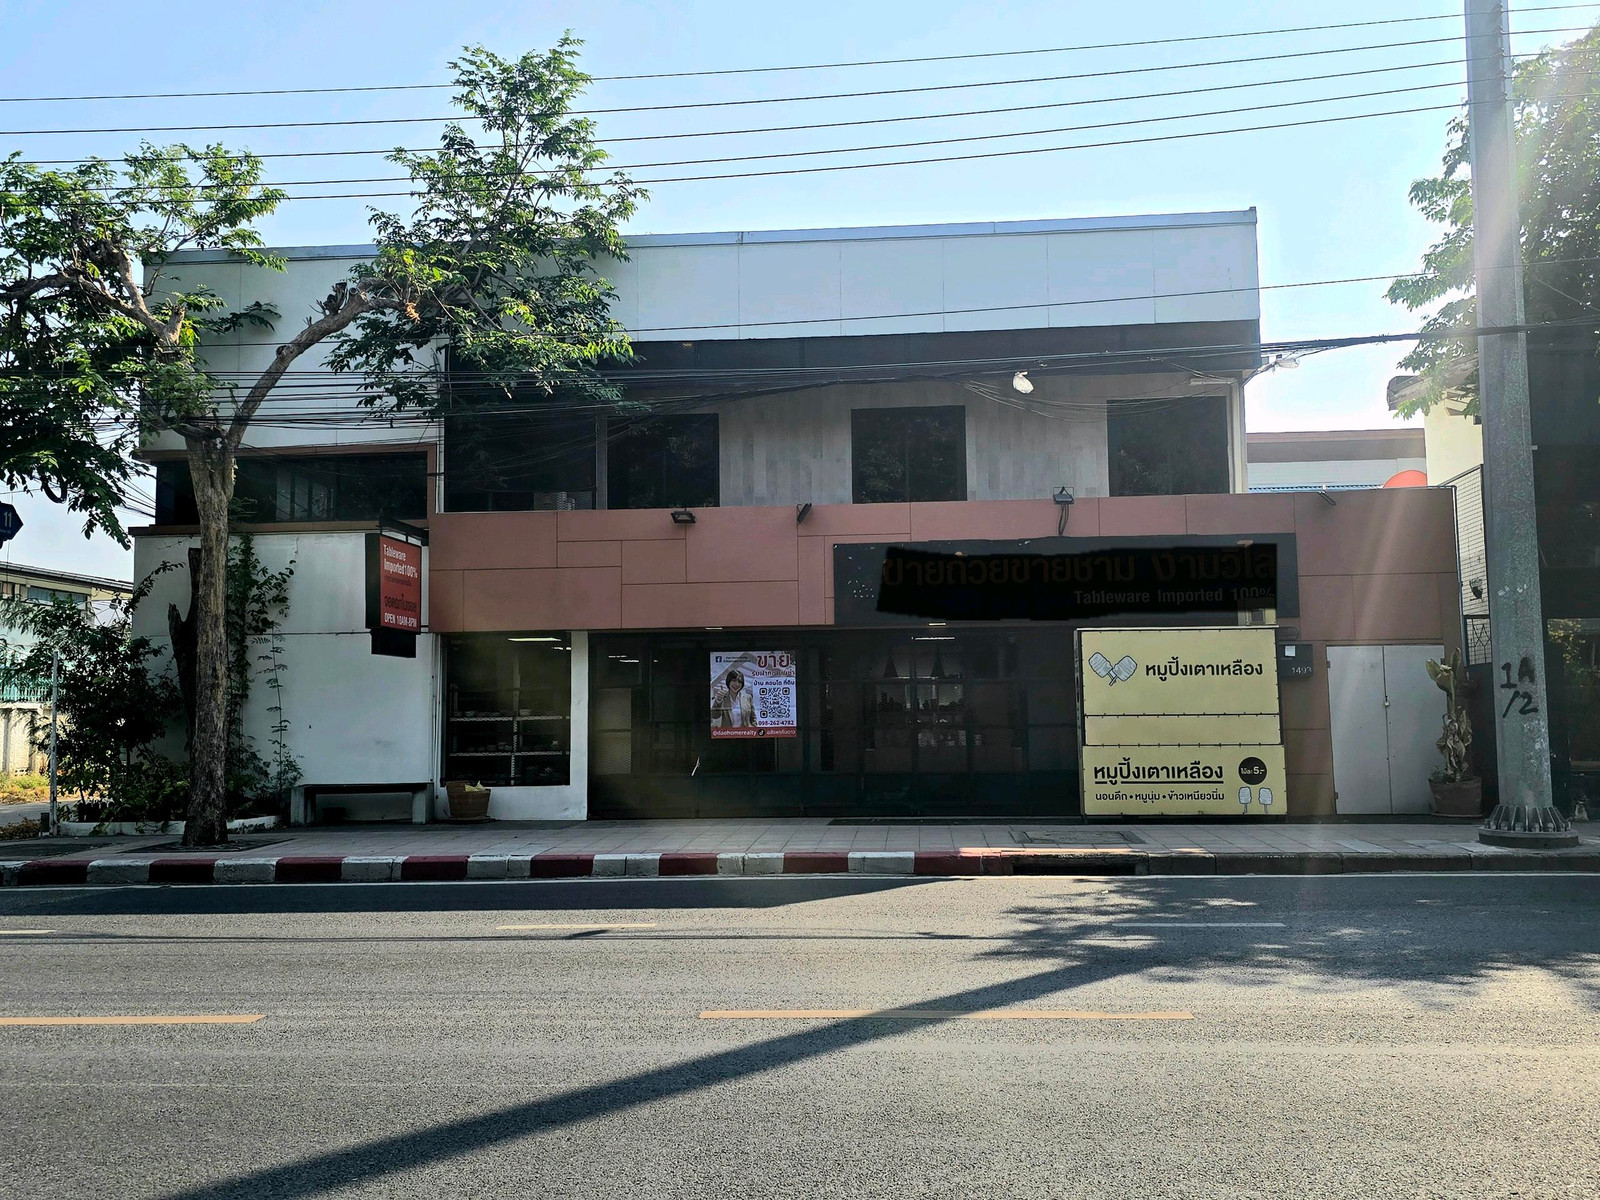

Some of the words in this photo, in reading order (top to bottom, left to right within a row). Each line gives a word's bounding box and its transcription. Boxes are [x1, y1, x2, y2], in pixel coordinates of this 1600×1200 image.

[383, 544, 405, 561] Tableware
[1073, 589, 1151, 605] Tableware
[1158, 588, 1223, 605] Imported
[384, 612, 396, 624] OPEN
[757, 655, 790, 667] ขาย
[1145, 656, 1264, 682] หมูปิ้งเตาเหลือง
[712, 729, 757, 737] @daohomerealty
[1094, 757, 1224, 786] หมูปิ้งเตาเหลือง
[1095, 790, 1128, 801] นอนดึก
[1134, 790, 1161, 804] หมูนุ่ม
[1168, 789, 1225, 801] ข้าวเหนียวนิ่ม
